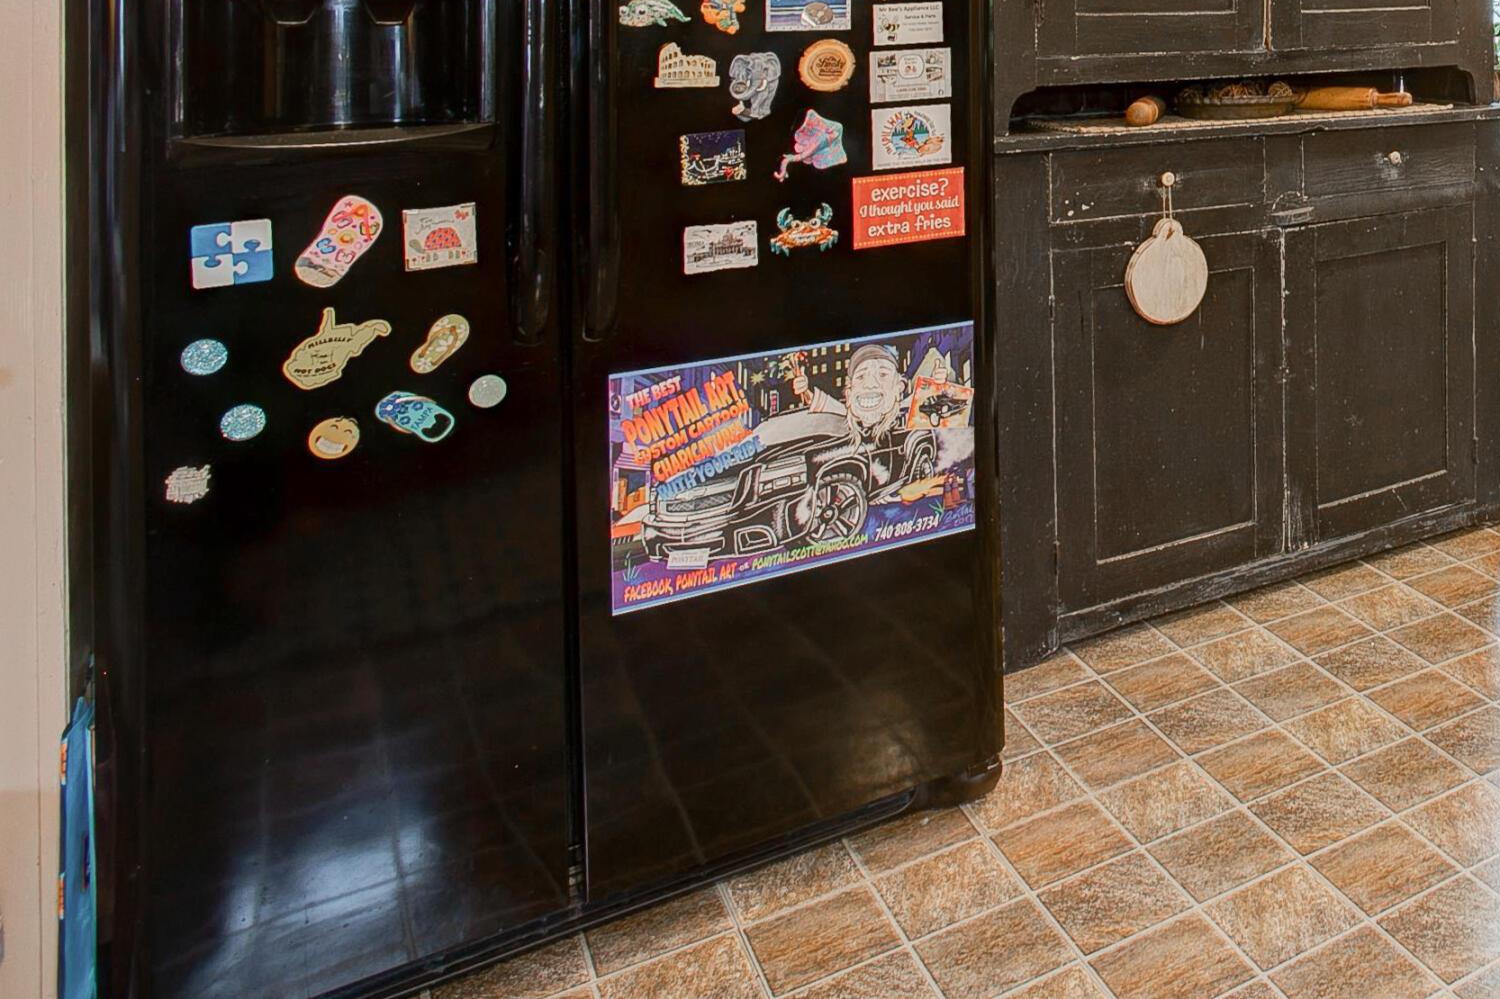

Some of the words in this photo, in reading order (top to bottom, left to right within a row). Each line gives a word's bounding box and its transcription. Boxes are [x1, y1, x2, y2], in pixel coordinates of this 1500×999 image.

[859, 205, 867, 217] I
[868, 200, 914, 218] thought
[914, 202, 934, 214] you
[935, 195, 960, 208] said
[871, 177, 949, 201] exercise?
[868, 221, 910, 237] extra
[914, 214, 952, 232] fries
[626, 387, 651, 409] THE
[651, 375, 682, 399] BEST
[621, 387, 709, 447] PONYTAIL
[633, 430, 688, 465] CUSTOM
[688, 398, 749, 439] CARTOON
[656, 470, 698, 500] WITH
[697, 452, 733, 482] YOUR
[734, 435, 766, 461] RIDE
[675, 570, 718, 592] PONYTAIL
[719, 562, 737, 581] ART
[875, 523, 893, 542] 740
[894, 513, 940, 535] 808-3734
